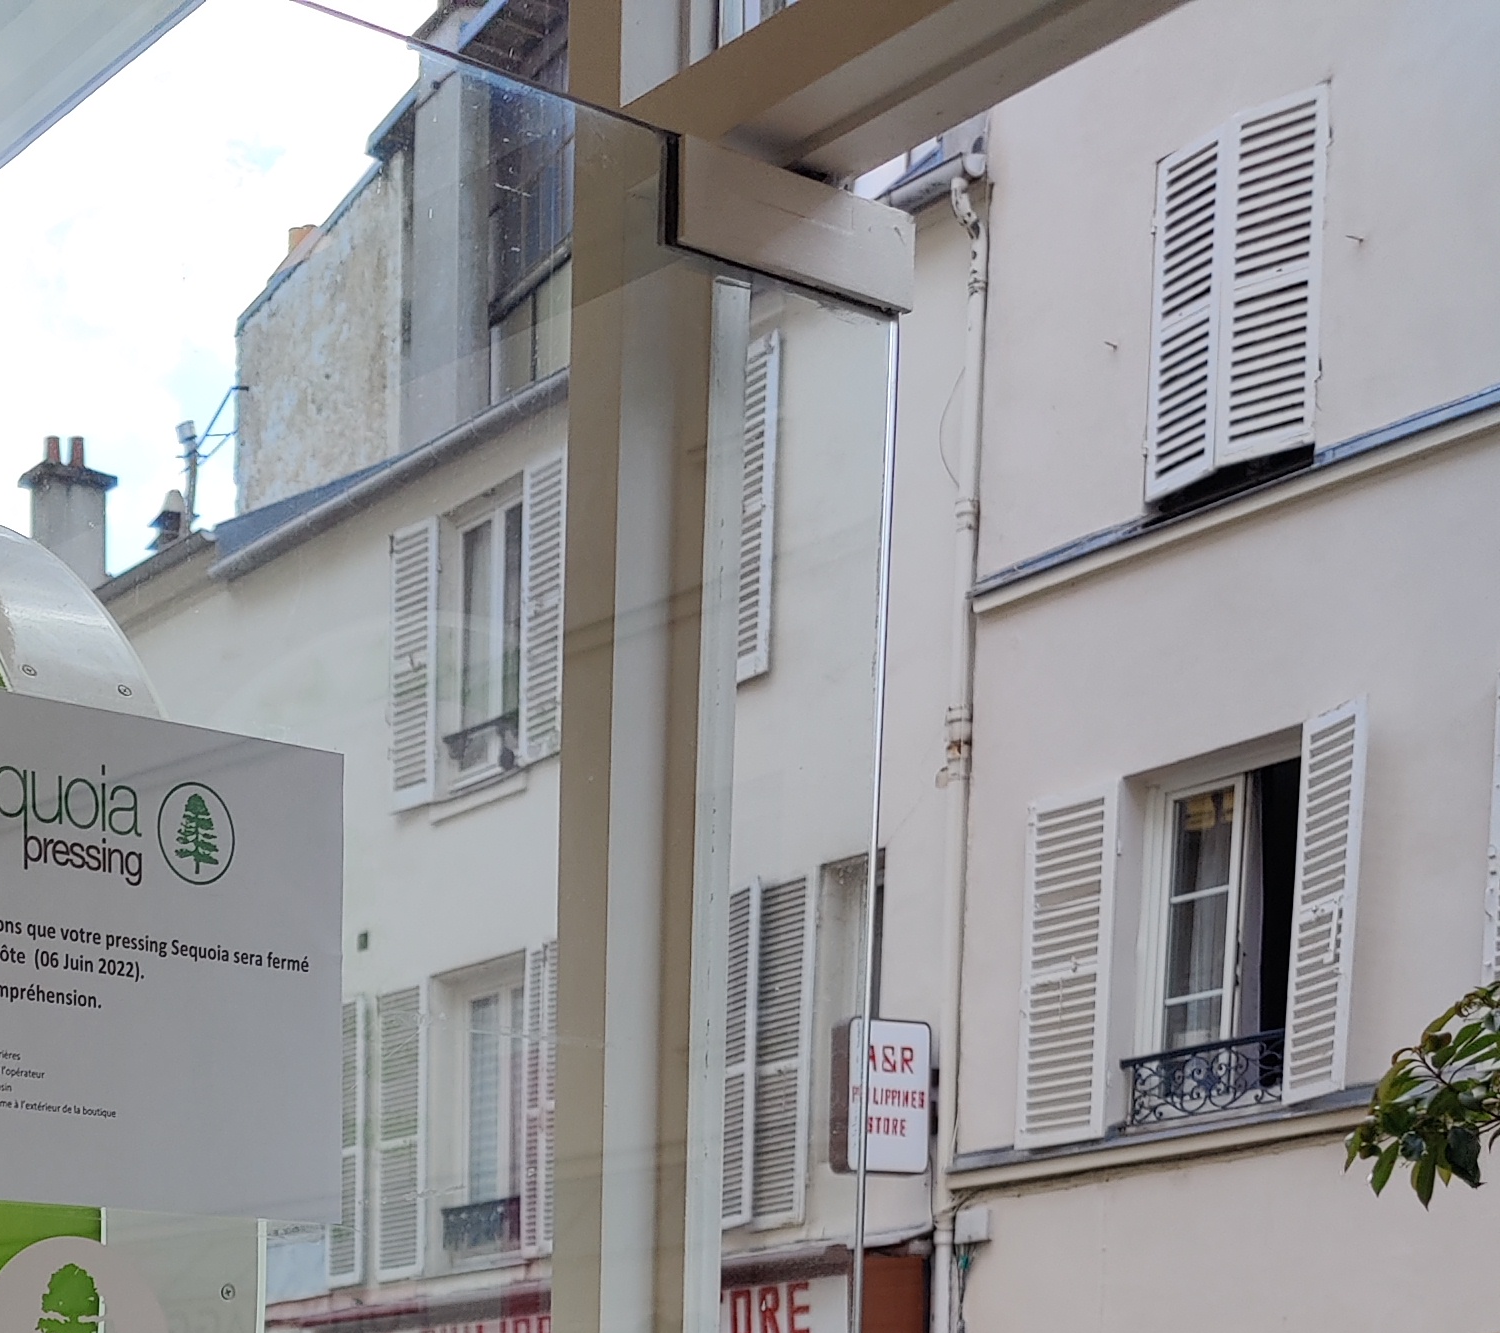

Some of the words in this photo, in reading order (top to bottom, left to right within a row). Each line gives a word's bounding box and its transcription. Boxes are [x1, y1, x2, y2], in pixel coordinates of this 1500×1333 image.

[23, 829, 143, 887] pressing
[27, 922, 56, 941] que
[60, 925, 102, 945] votre
[105, 931, 167, 958] pressing
[171, 939, 229, 962] Sequoia
[233, 950, 263, 967] sera
[266, 951, 309, 973] fermé
[33, 948, 59, 970] (06
[63, 953, 94, 973] Juin
[98, 957, 145, 983] 2022).
[1, 1065, 45, 1080] l'opérateur
[869, 1045, 915, 1075] A&R
[14, 1099, 19, 1109] à
[20, 1100, 61, 1113] l'extérieur
[62, 1104, 72, 1114] de
[74, 1105, 81, 1115] la
[82, 1106, 117, 1119] boutique
[851, 1085, 926, 1110] PLIPPINES
[868, 1116, 907, 1138] STORE
